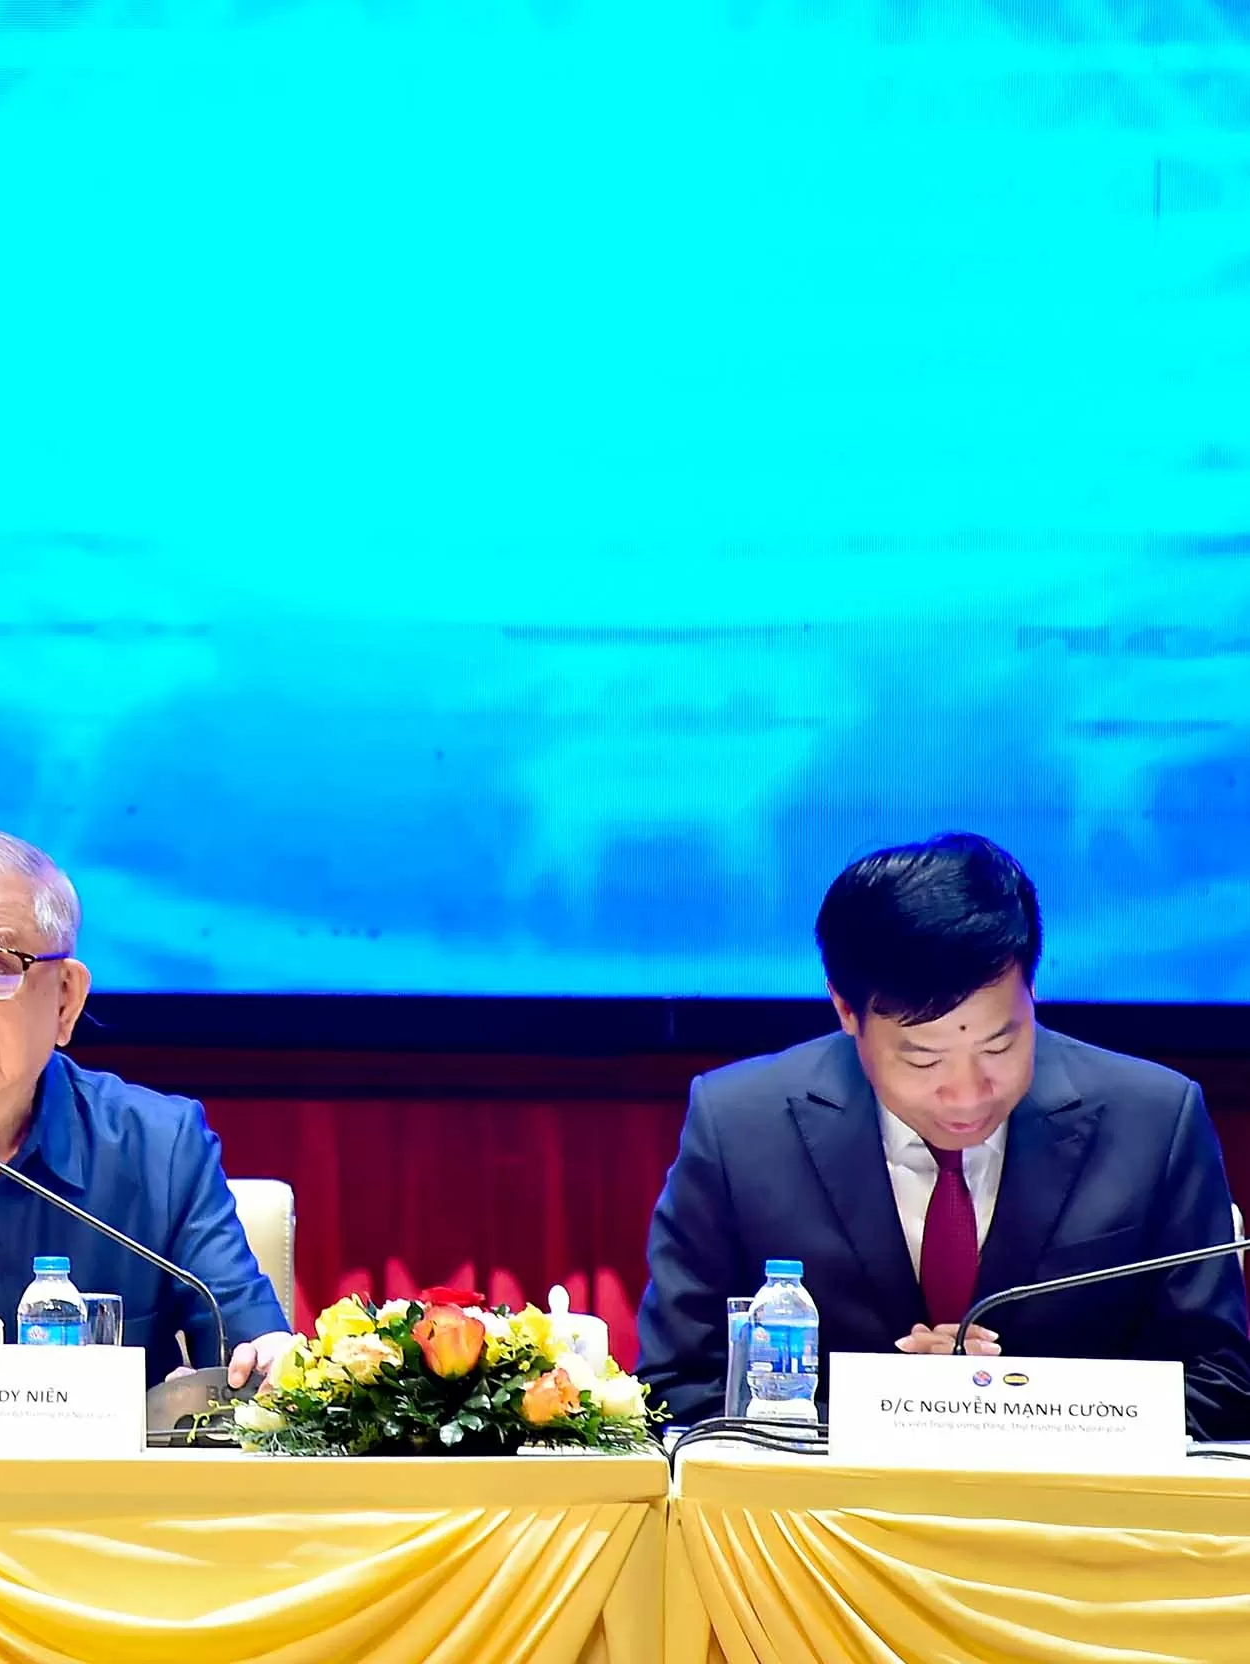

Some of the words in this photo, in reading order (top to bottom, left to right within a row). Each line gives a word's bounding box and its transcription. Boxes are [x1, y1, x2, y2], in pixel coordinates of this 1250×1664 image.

[26, 1387, 69, 1404] NIÊN
[880, 1398, 914, 1414] Đ/C
[920, 1396, 997, 1415] NGUYỄN
[1003, 1402, 1062, 1418] MẠNH
[1068, 1401, 1139, 1418] CƯỜNG
